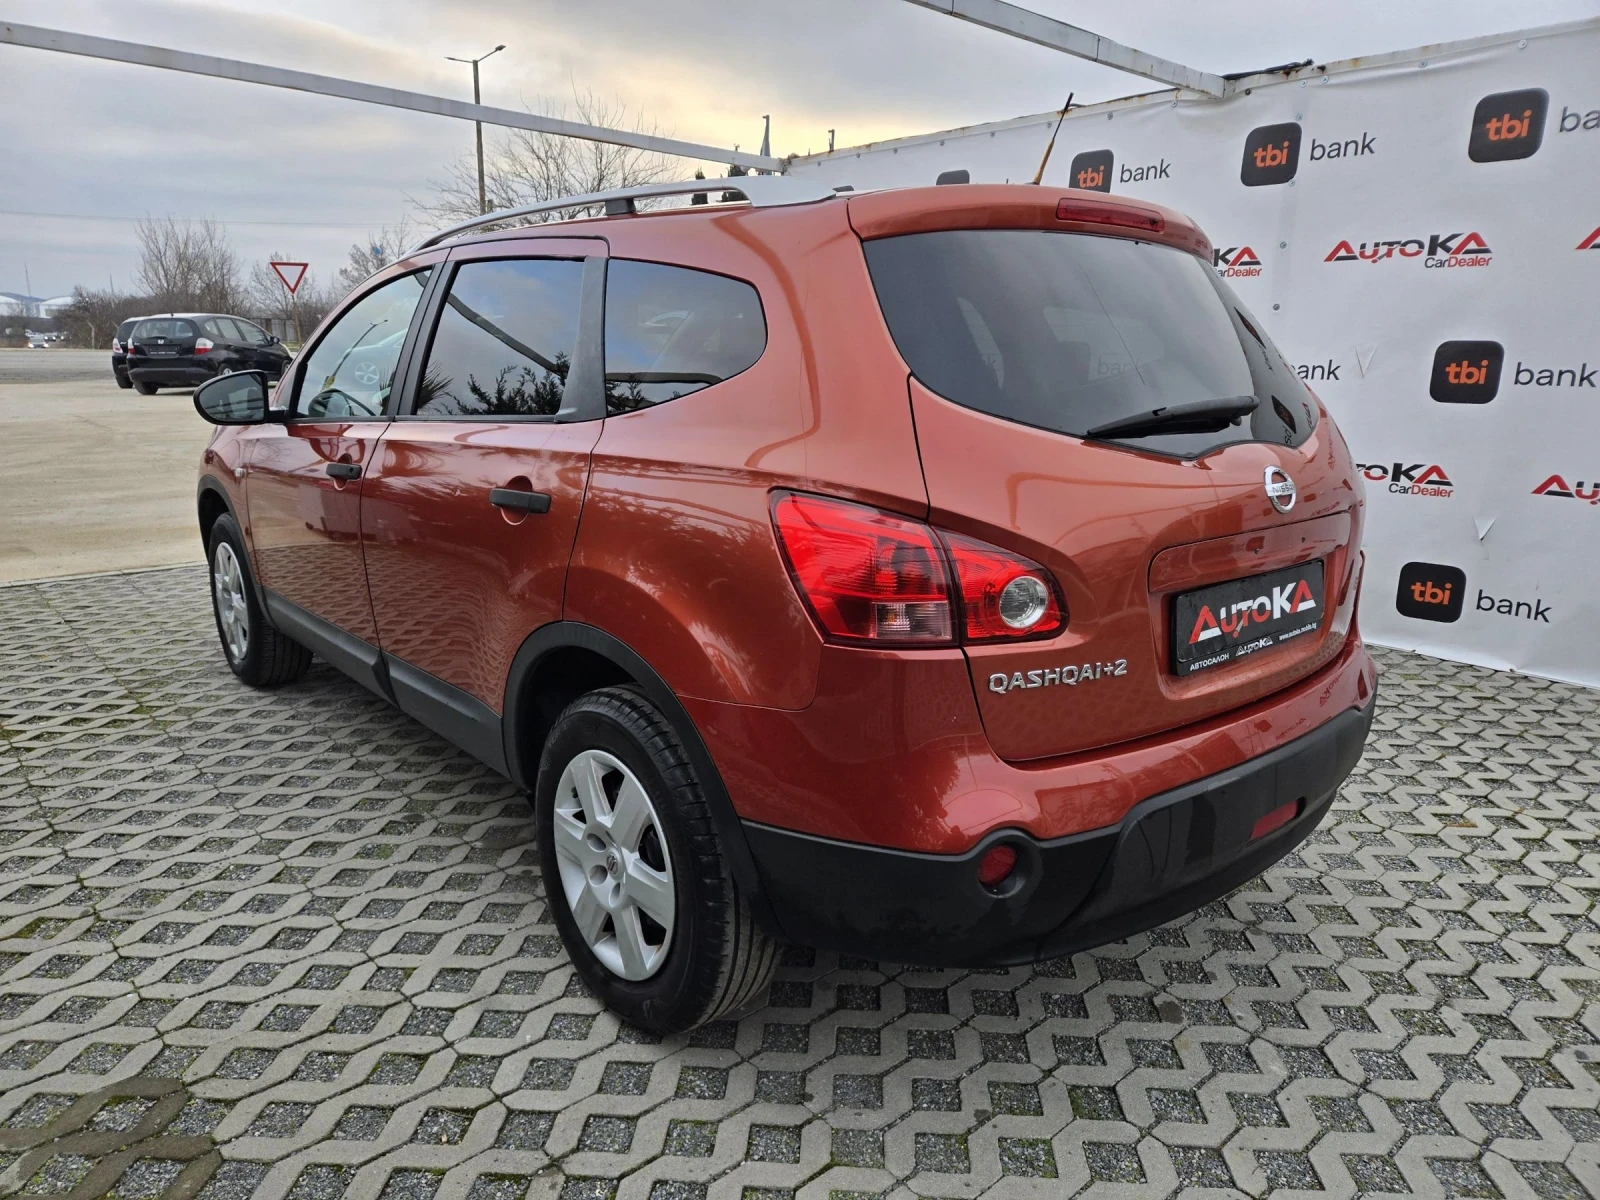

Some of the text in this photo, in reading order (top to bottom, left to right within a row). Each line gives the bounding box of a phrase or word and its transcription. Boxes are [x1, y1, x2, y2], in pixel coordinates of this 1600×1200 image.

[1486, 109, 1532, 141] tbi
[1254, 132, 1377, 168] tbi bank
[1078, 158, 1172, 188] tbi bank
[1323, 231, 1493, 264] AUTOKA
[1424, 254, 1493, 269] CarDealer
[1214, 267, 1262, 278] arDealer
[1291, 359, 1341, 381] ank
[1445, 359, 1600, 388] tbi bank
[1388, 482, 1453, 498] CarDealer
[1188, 579, 1316, 645] AUTOKA
[1410, 581, 1552, 623] tbi bank
[988, 658, 1128, 694] QASHQAI+2
[1189, 652, 1230, 672] АВТОСАЛОН
